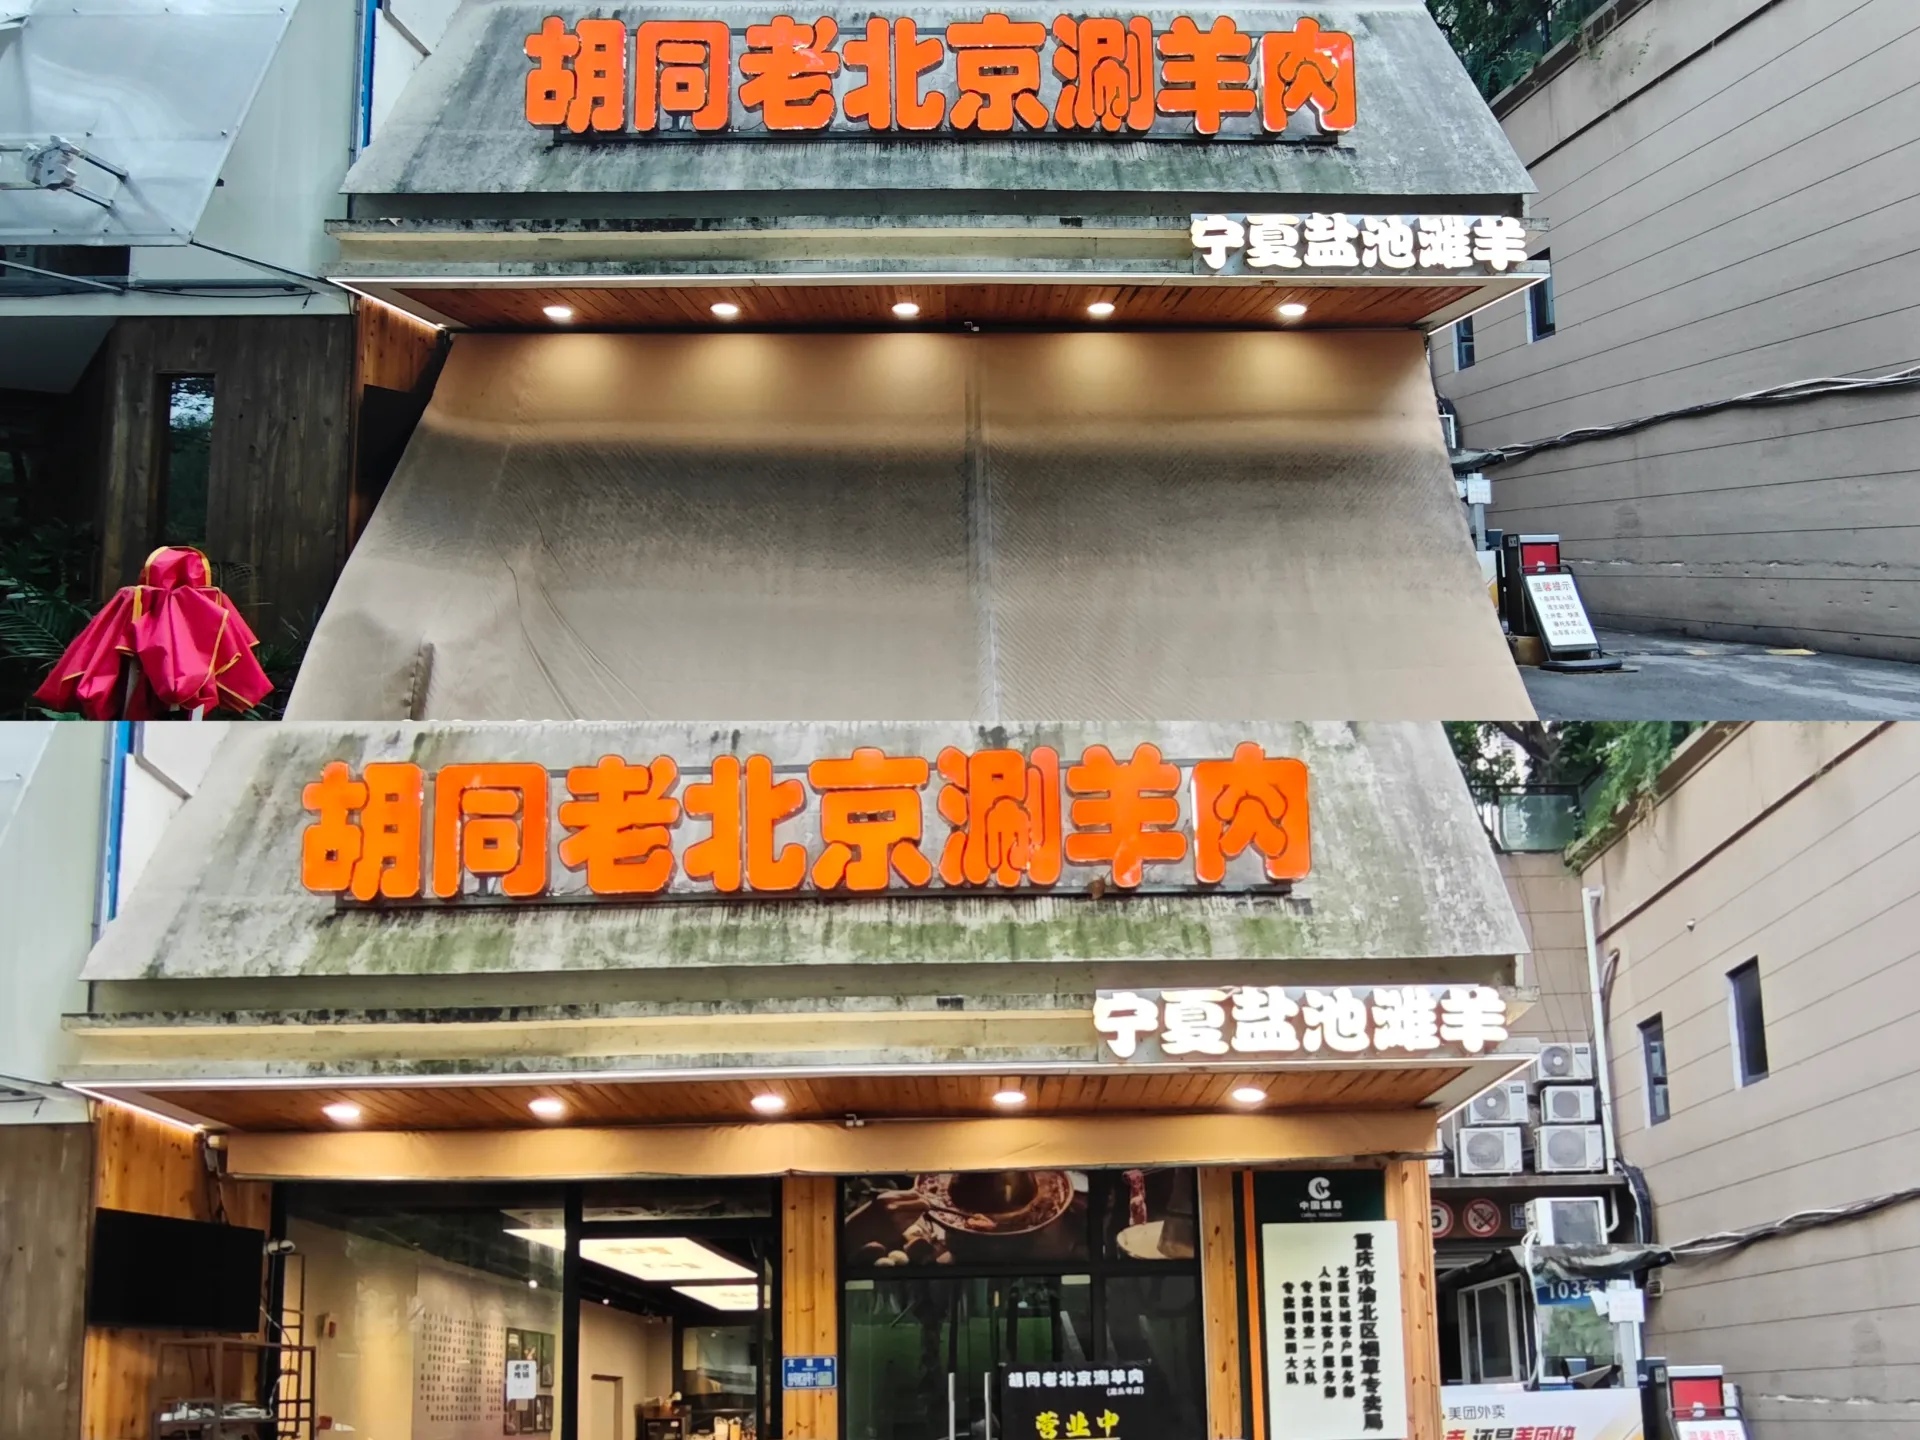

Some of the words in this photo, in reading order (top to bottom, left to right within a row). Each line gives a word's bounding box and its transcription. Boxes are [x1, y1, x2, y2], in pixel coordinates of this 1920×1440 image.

[523, 13, 1358, 135] 胡同老北京涮羊肉
[1191, 212, 1528, 271] 宁夏盐池滩羊
[301, 742, 1312, 901] 胡同老北京涮羊肉
[1093, 986, 1508, 1057] 宁夏盐池滩羊
[1318, 1265, 1337, 1399] 人和区域客户服务部
[1353, 1232, 1383, 1431] 重庆市渝北区烟草专卖局
[1008, 1368, 1145, 1388] 胡同老北京涮羊肉
[1448, 1404, 1505, 1420] 美团外卖
[1035, 1408, 1120, 1439] 营业中
